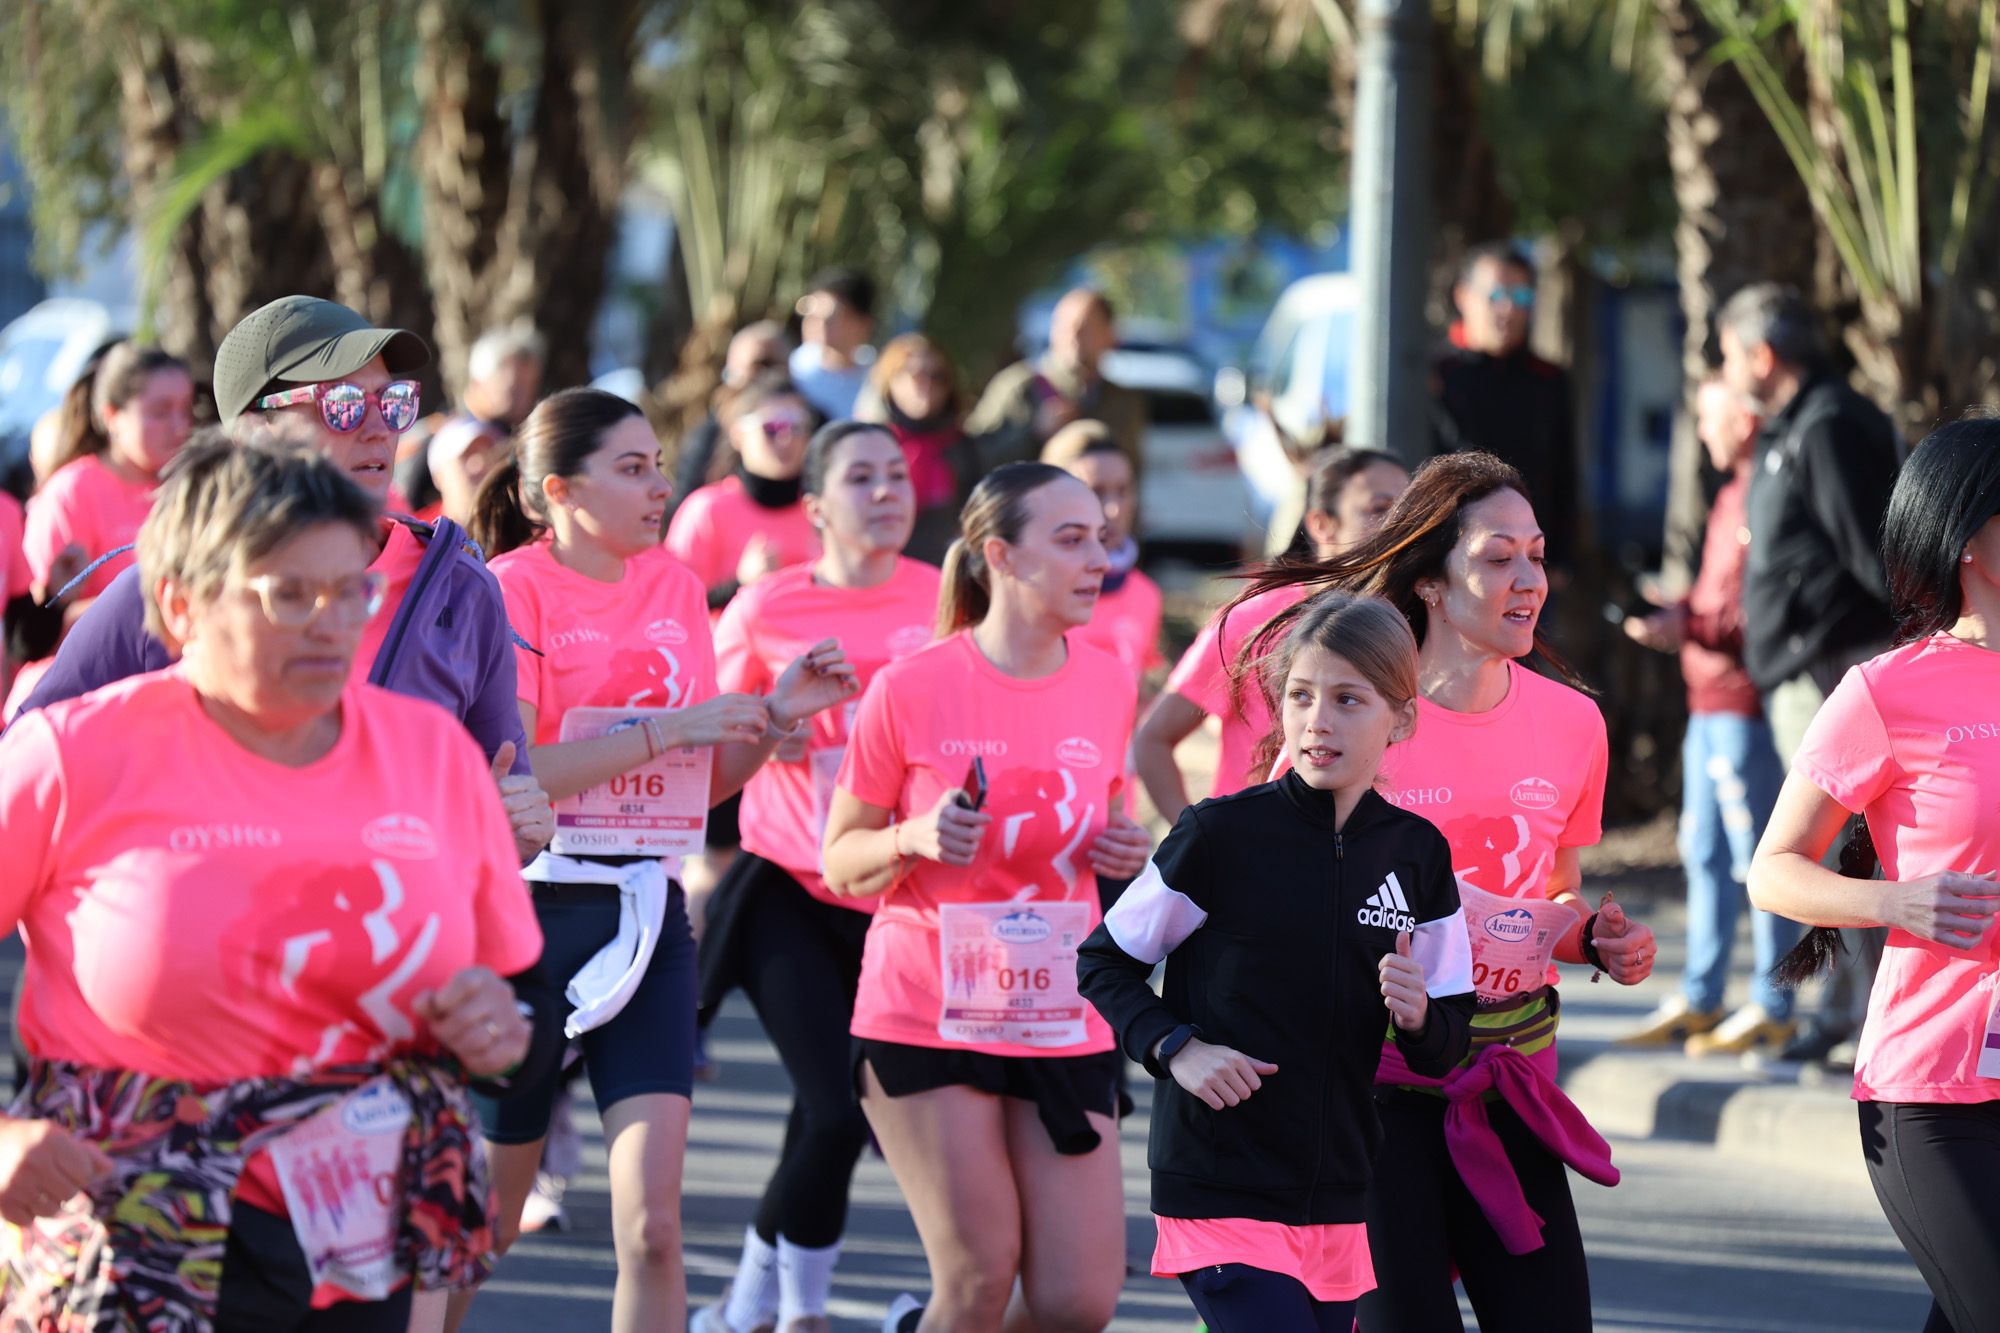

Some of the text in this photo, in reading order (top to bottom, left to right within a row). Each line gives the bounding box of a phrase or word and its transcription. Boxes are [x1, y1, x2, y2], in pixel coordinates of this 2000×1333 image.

[940, 739, 1008, 756] OYSHO
[610, 774, 665, 797] 016
[170, 823, 282, 852] OYSHO
[570, 833, 618, 846] OYSHO
[1357, 906, 1416, 933] adidas
[998, 968, 1051, 991] 016
[1472, 962, 1522, 993] 016
